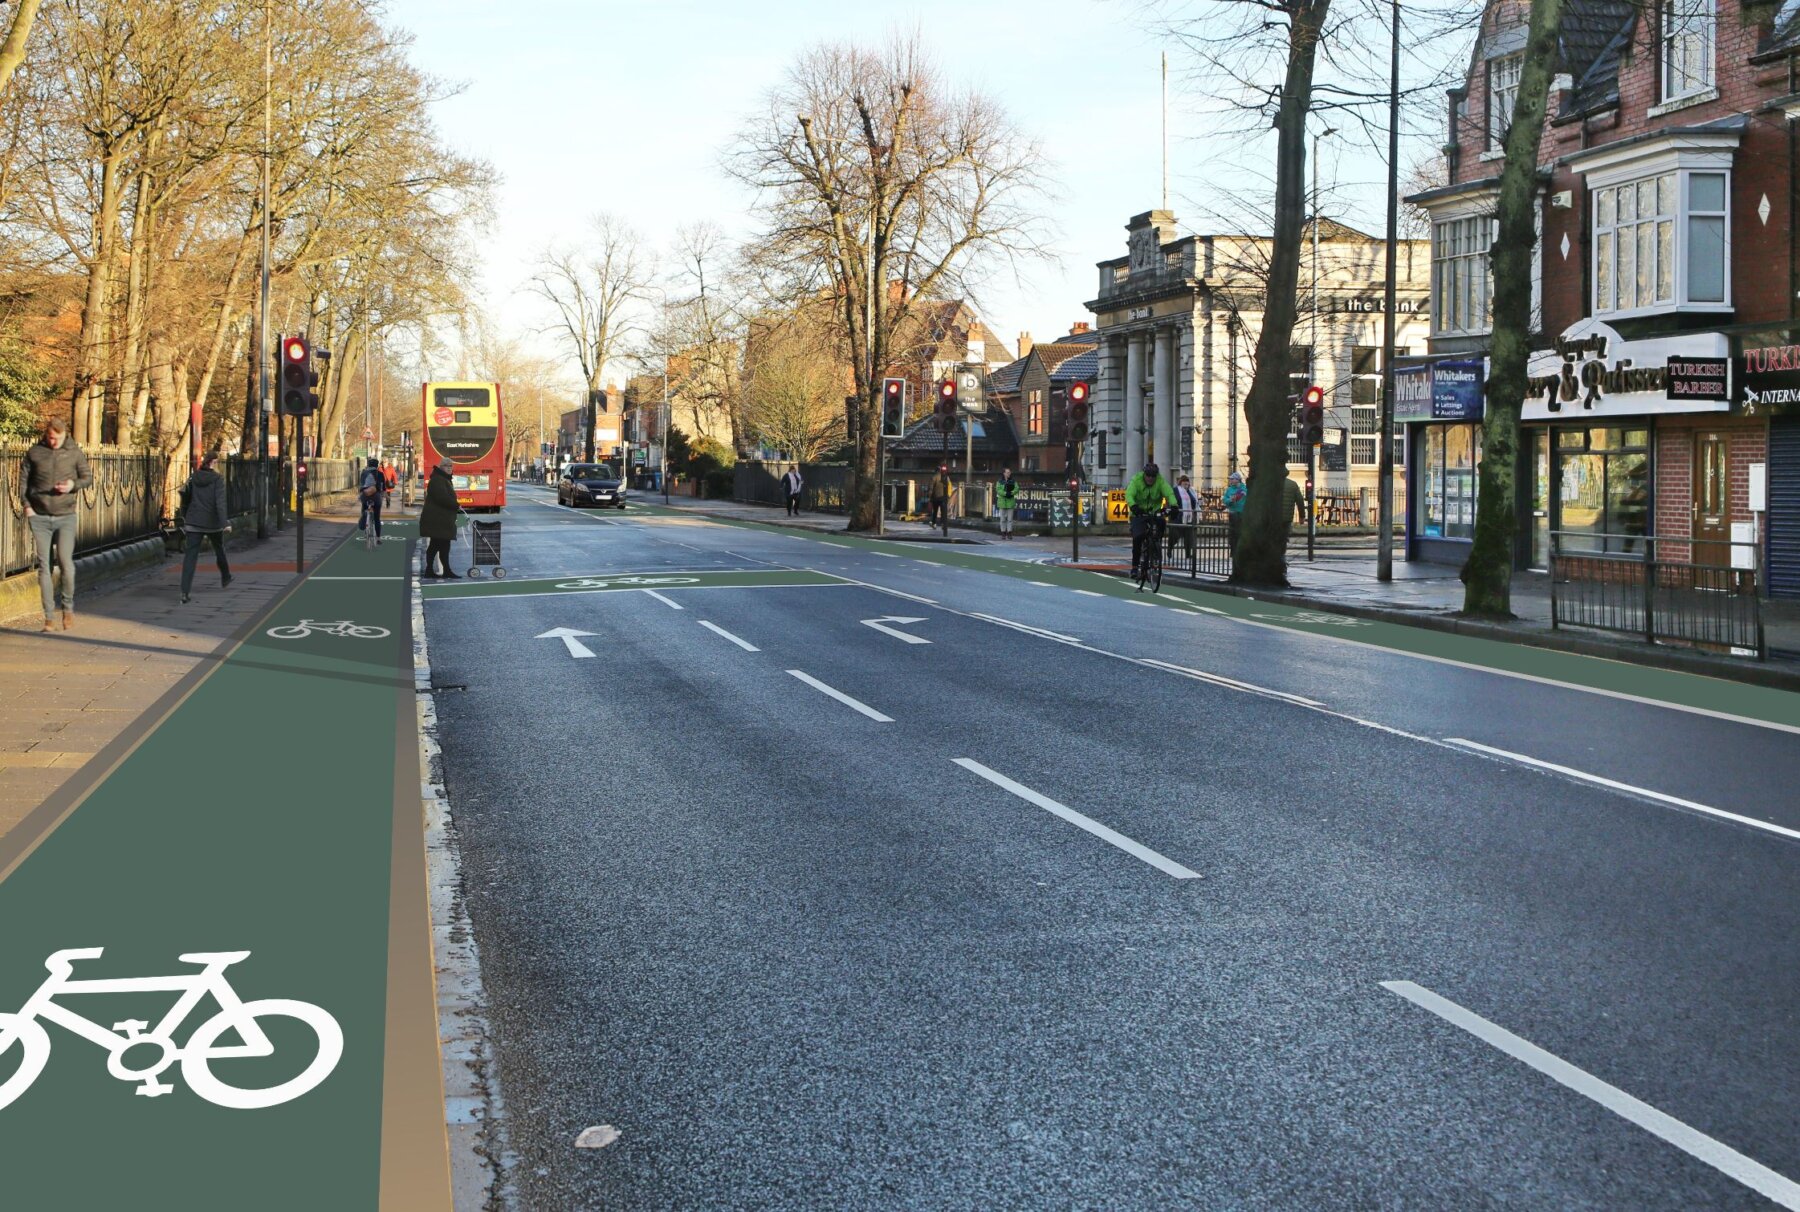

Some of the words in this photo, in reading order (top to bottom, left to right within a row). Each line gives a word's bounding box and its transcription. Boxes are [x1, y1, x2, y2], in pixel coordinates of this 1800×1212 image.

[1348, 299, 1372, 311] the
[1379, 299, 1418, 312] bnk
[1744, 345, 1800, 373] TURKI
[1434, 370, 1476, 381] Whitakers
[1669, 363, 1725, 376] TURKISH
[1674, 382, 1724, 395] BARBER
[1030, 490, 1050, 501] HULL
[1112, 503, 1129, 519] 44
